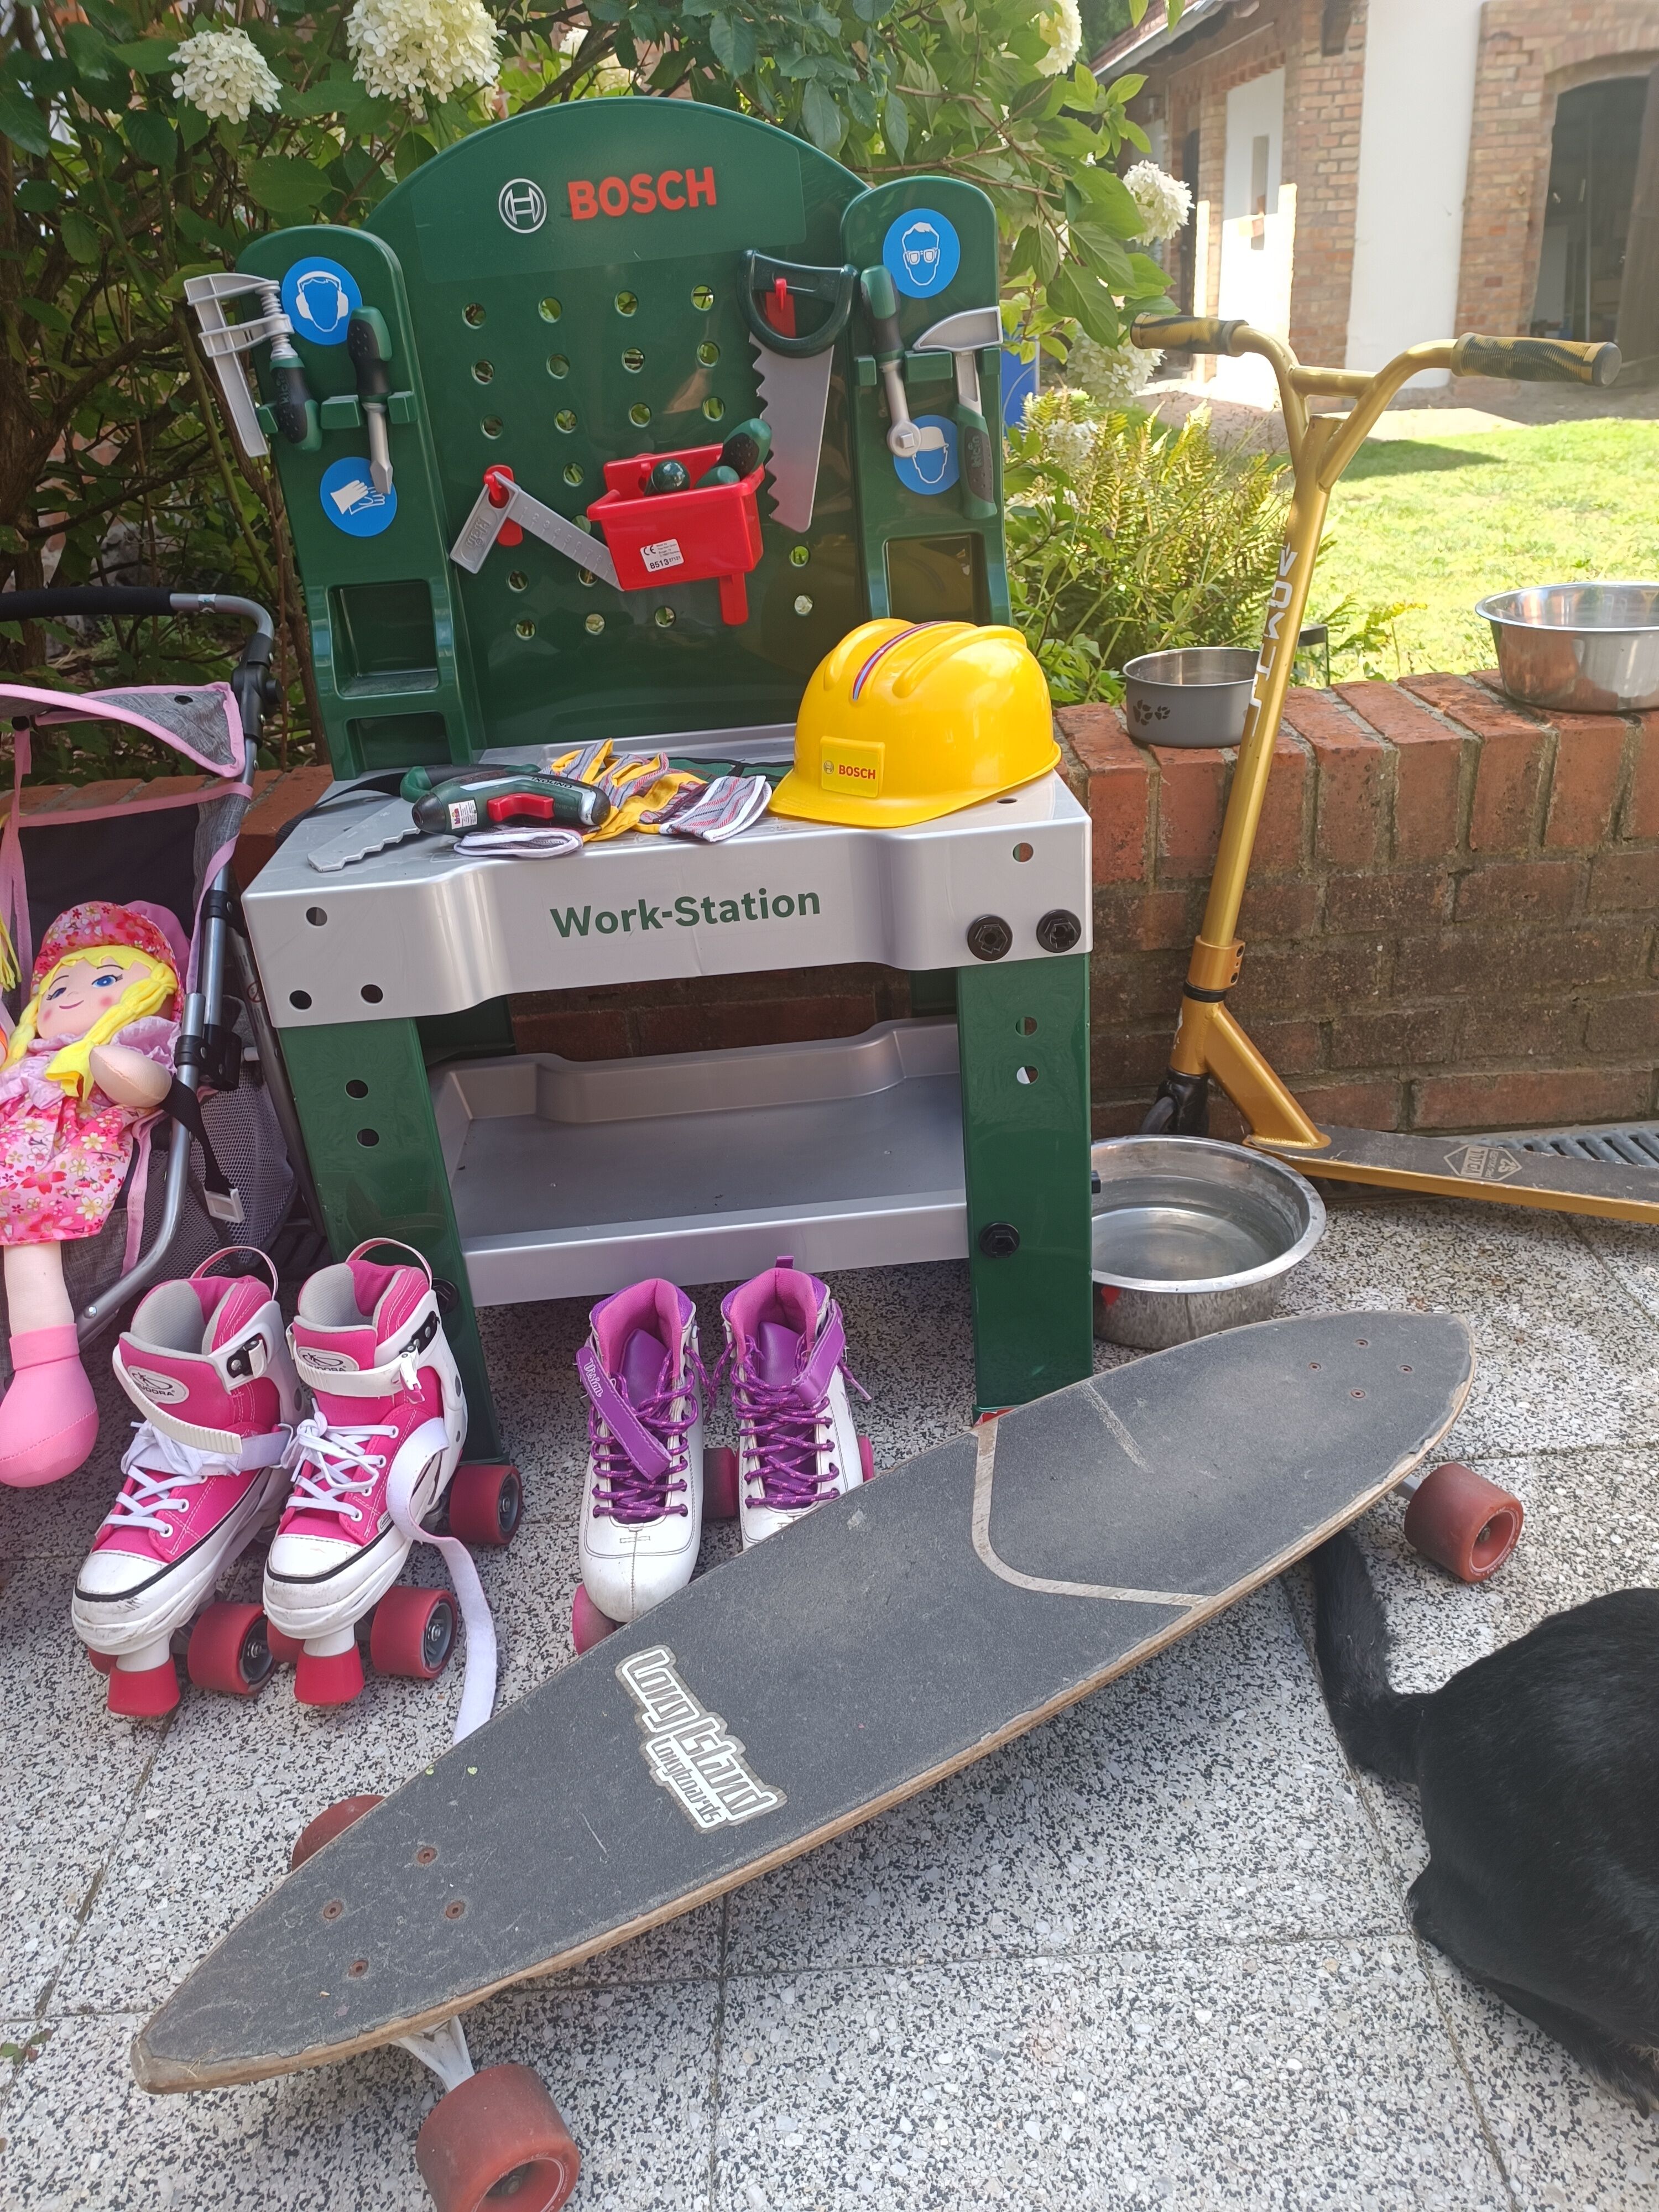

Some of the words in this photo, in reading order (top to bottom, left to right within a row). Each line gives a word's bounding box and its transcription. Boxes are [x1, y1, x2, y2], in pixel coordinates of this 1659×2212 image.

[567, 166, 717, 221] BOSCH
[650, 559, 669, 569] 8513
[531, 776, 573, 789] IXOLINO
[838, 764, 876, 780] BOSCH
[549, 888, 821, 938] Work-Station
[584, 1357, 603, 1397] Vision
[624, 1650, 697, 1730] Long
[671, 1719, 774, 1817] Island
